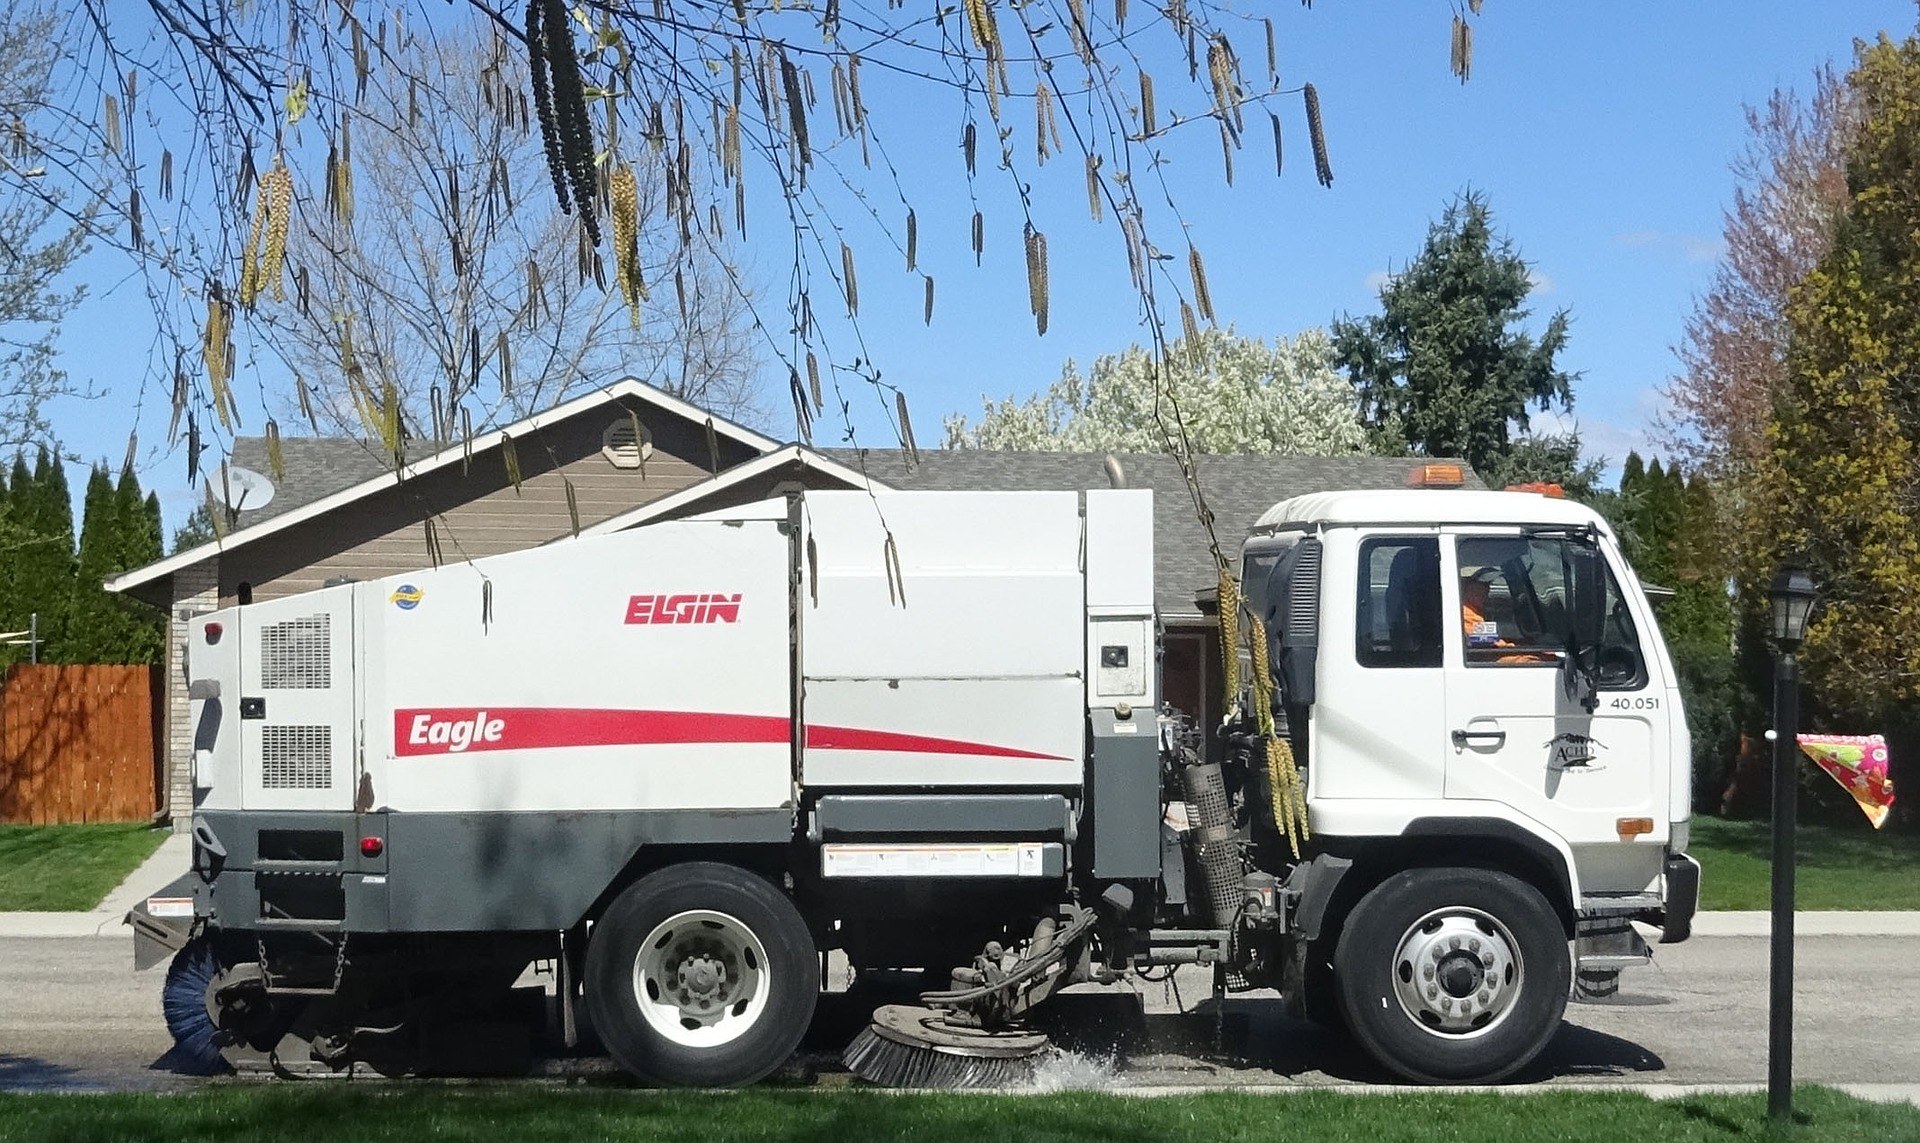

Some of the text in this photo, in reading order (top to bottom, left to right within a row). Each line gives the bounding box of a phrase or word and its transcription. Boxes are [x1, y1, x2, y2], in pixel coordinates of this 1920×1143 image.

[624, 593, 743, 625] ELGIN
[1610, 697, 1660, 710] 40.051
[408, 711, 506, 752] Eagle
